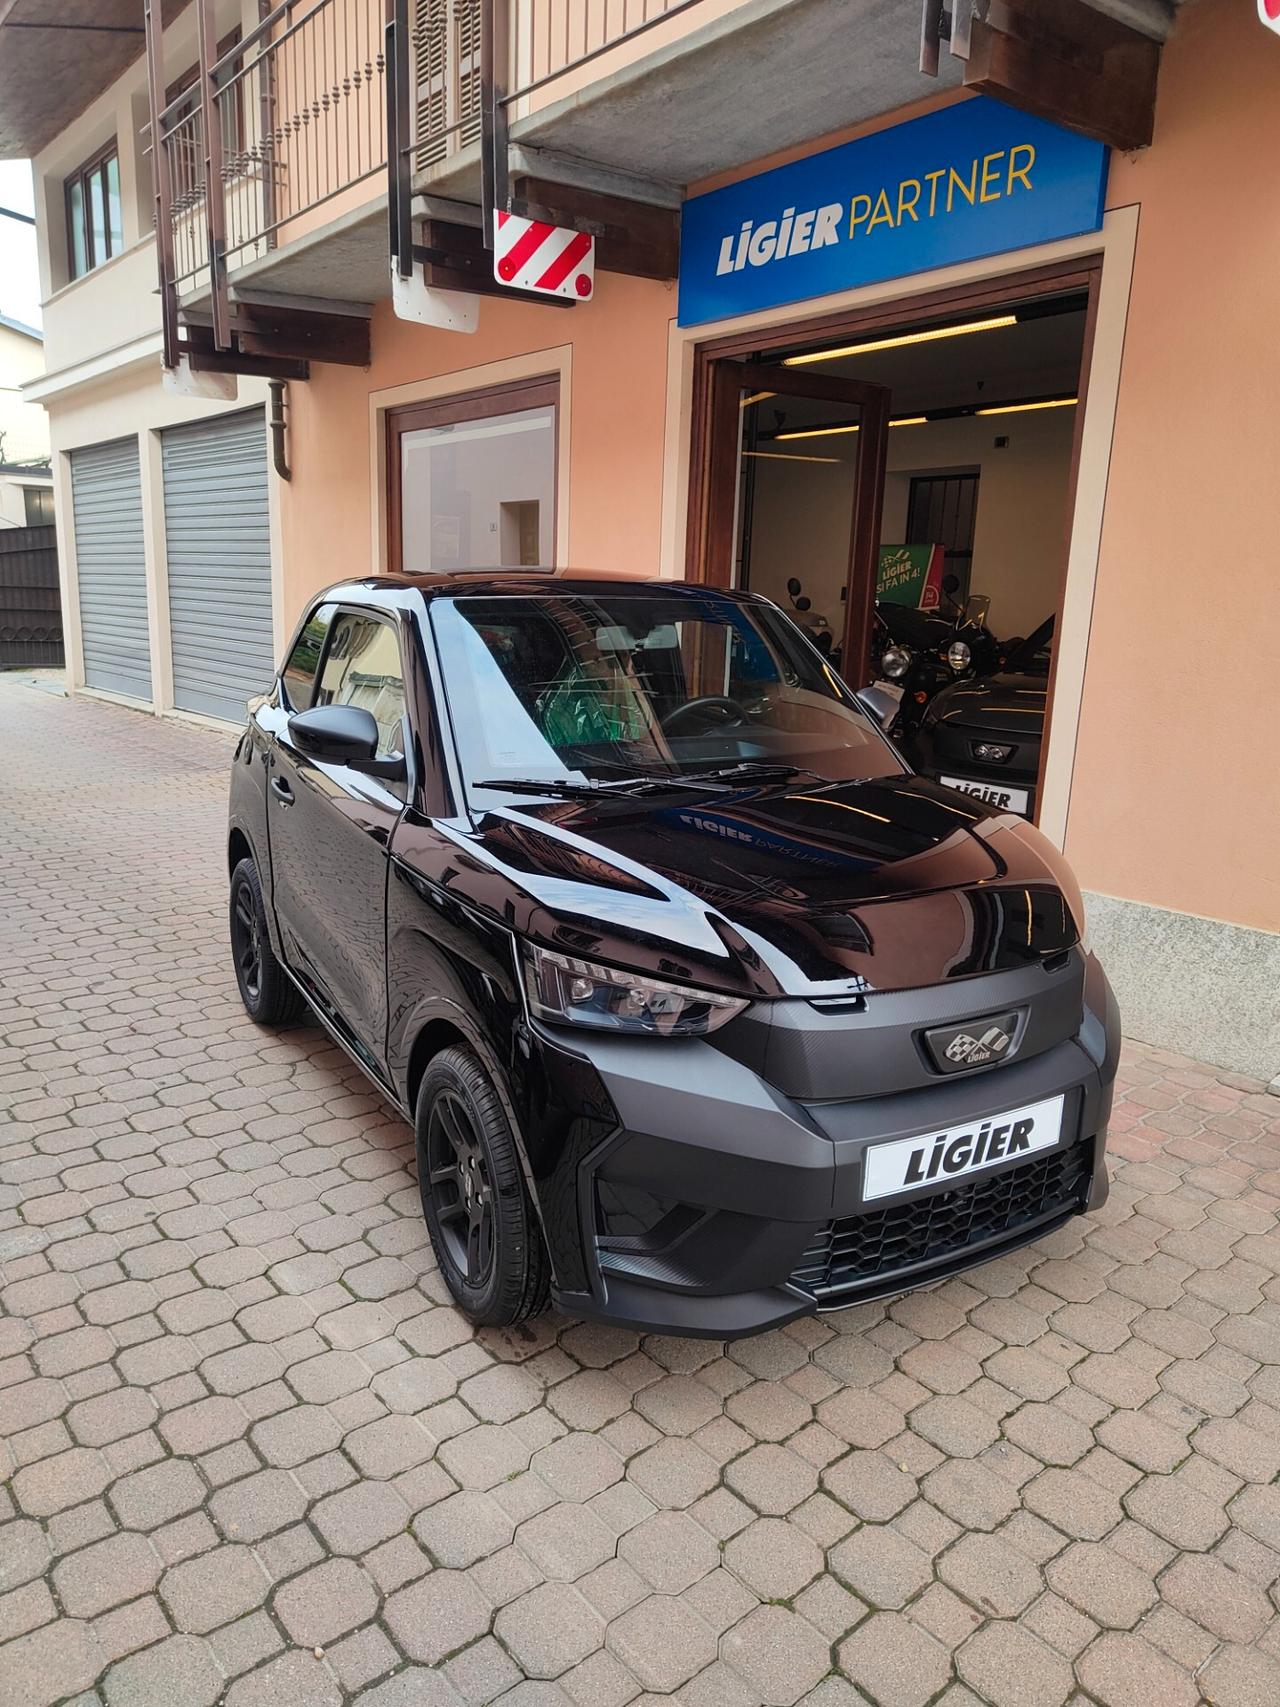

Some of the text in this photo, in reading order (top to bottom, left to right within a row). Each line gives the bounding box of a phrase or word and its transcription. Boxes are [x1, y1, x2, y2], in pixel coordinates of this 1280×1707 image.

[849, 144, 1036, 240] PARTNER
[885, 577, 898, 591] FA
[900, 571, 910, 584] IN
